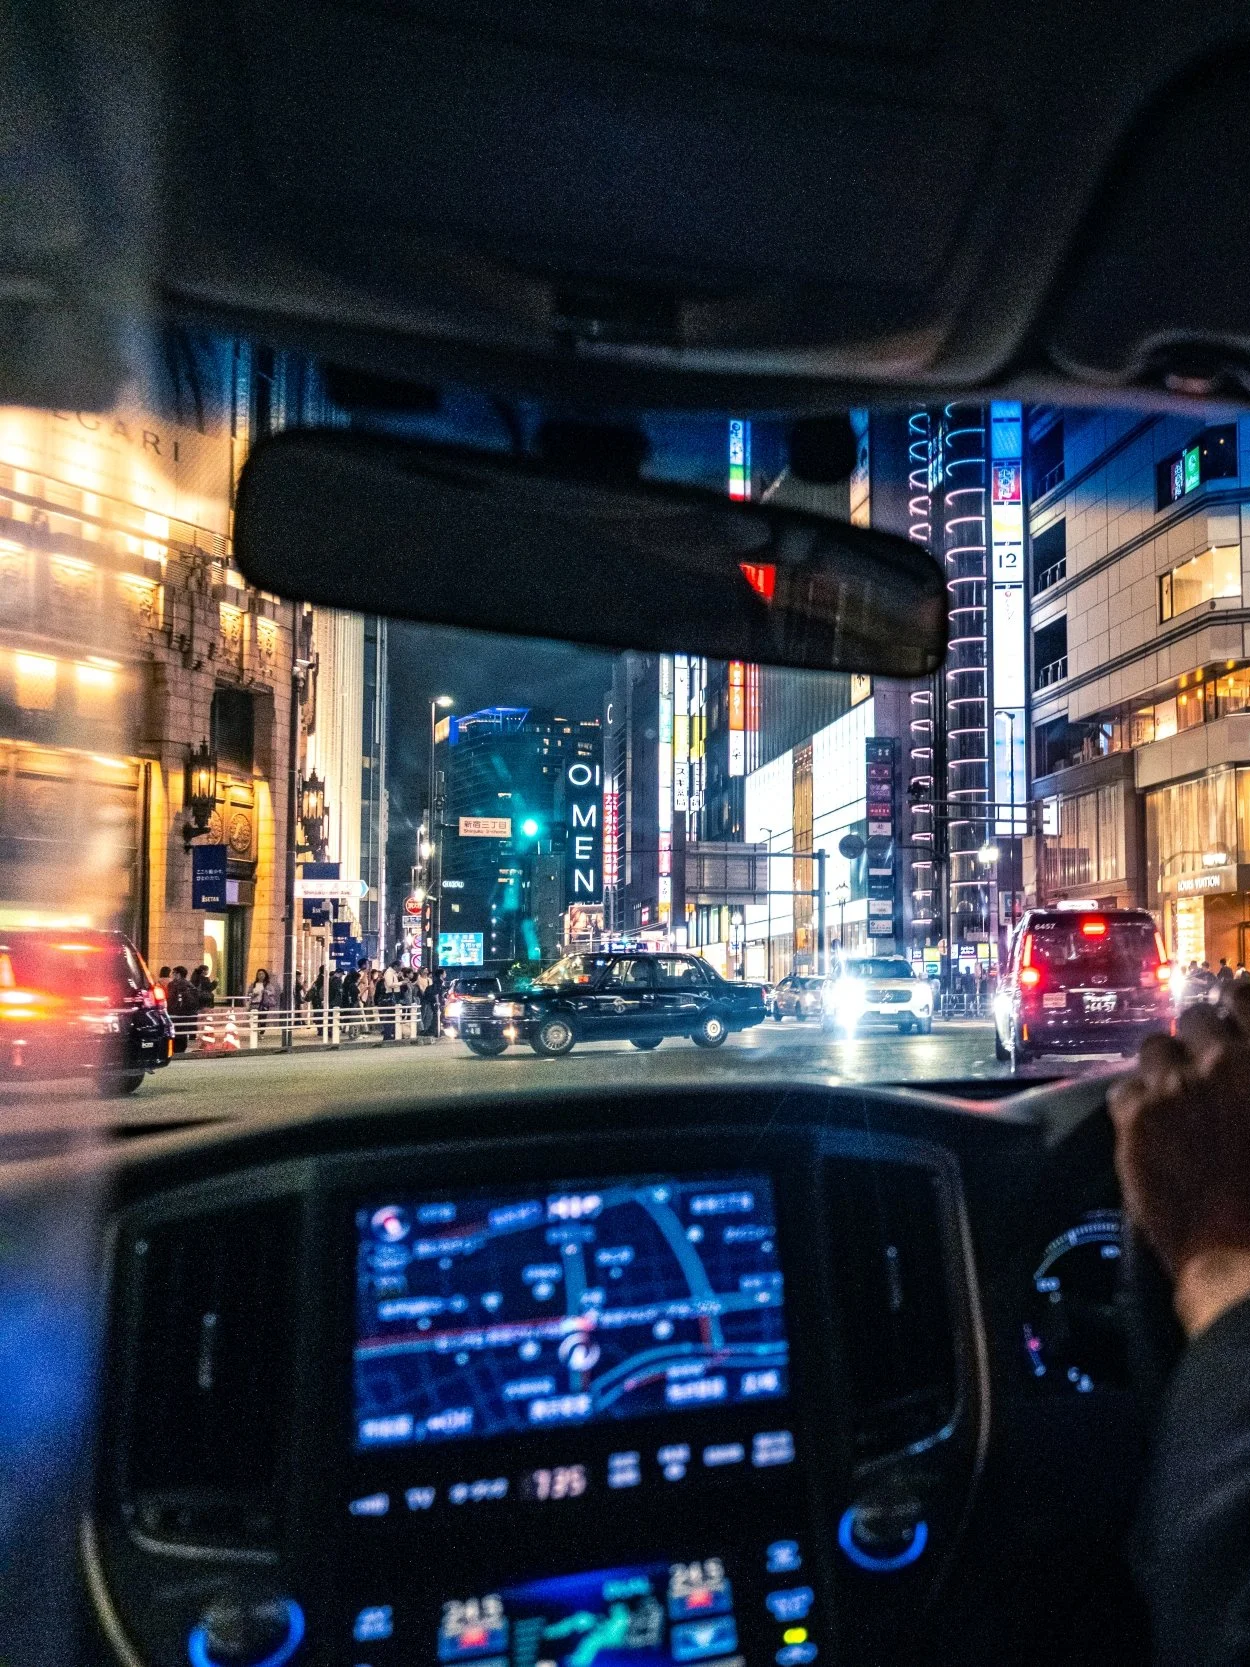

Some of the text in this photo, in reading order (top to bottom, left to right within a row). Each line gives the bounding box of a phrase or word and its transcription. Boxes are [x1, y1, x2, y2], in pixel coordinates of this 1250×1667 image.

[463, 820, 507, 830] 新宿三丁目
[572, 803, 597, 893] MEN
[1177, 875, 1221, 893] LOUIS VUITTON
